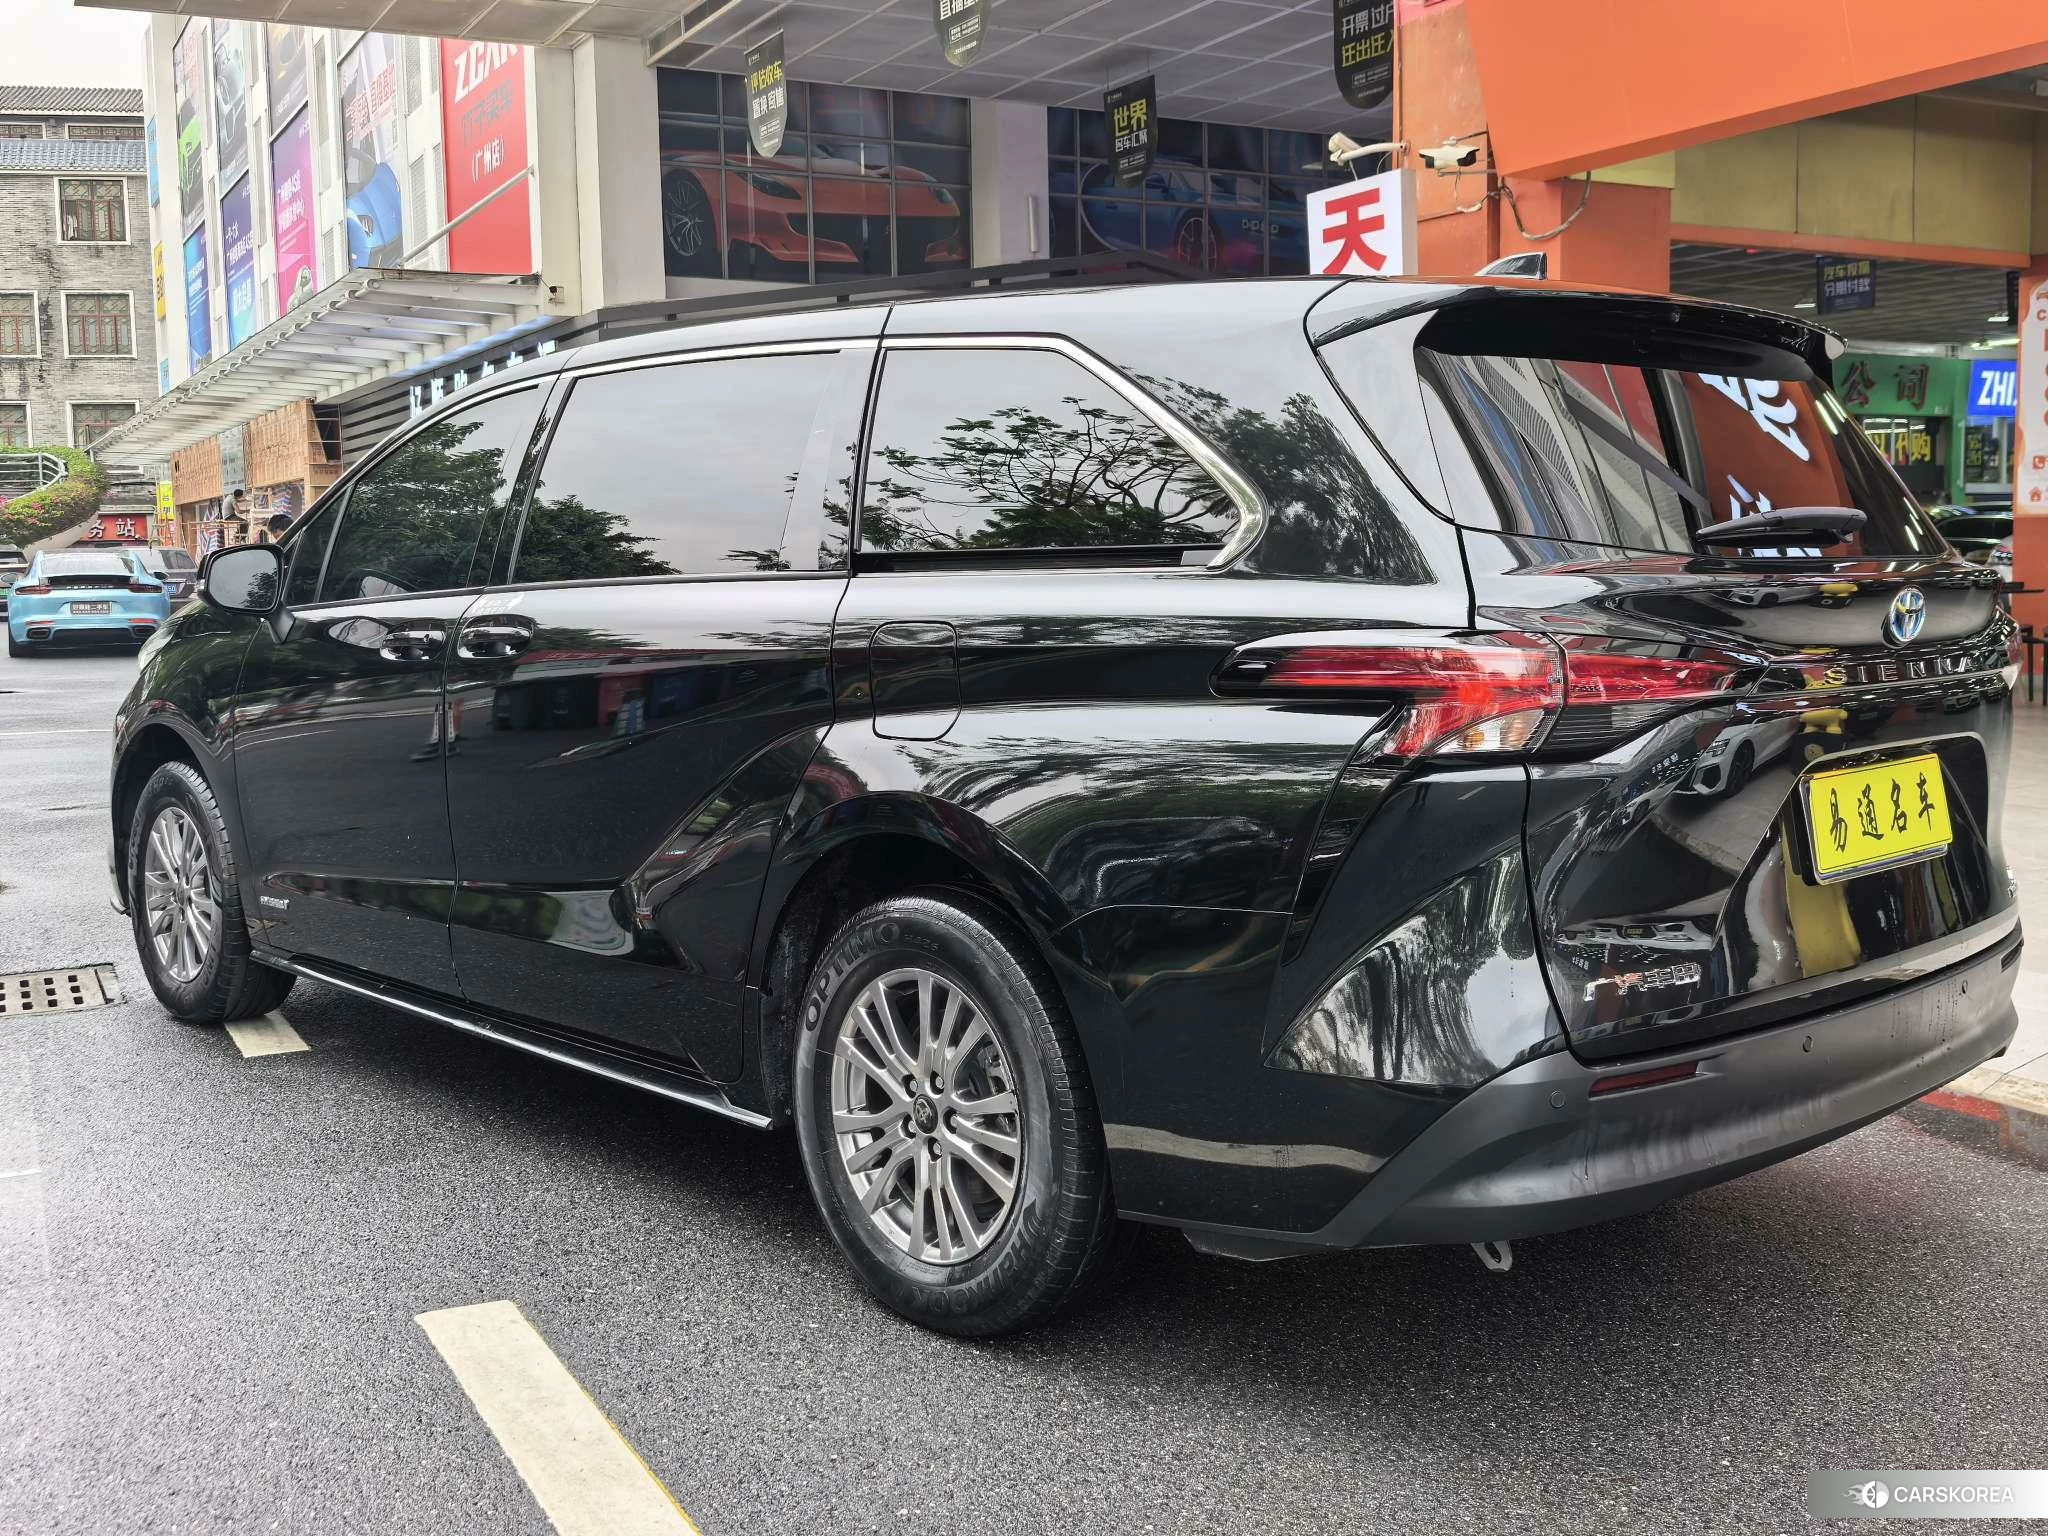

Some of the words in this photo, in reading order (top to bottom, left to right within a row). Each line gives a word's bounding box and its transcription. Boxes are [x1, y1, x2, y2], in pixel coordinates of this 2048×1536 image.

[1114, 99, 1147, 137] 世界
[1322, 187, 1388, 275] 天
[1842, 361, 1930, 411] 公司
[1824, 655, 1973, 685] SIENNA
[805, 922, 901, 1032] OPTIMO
